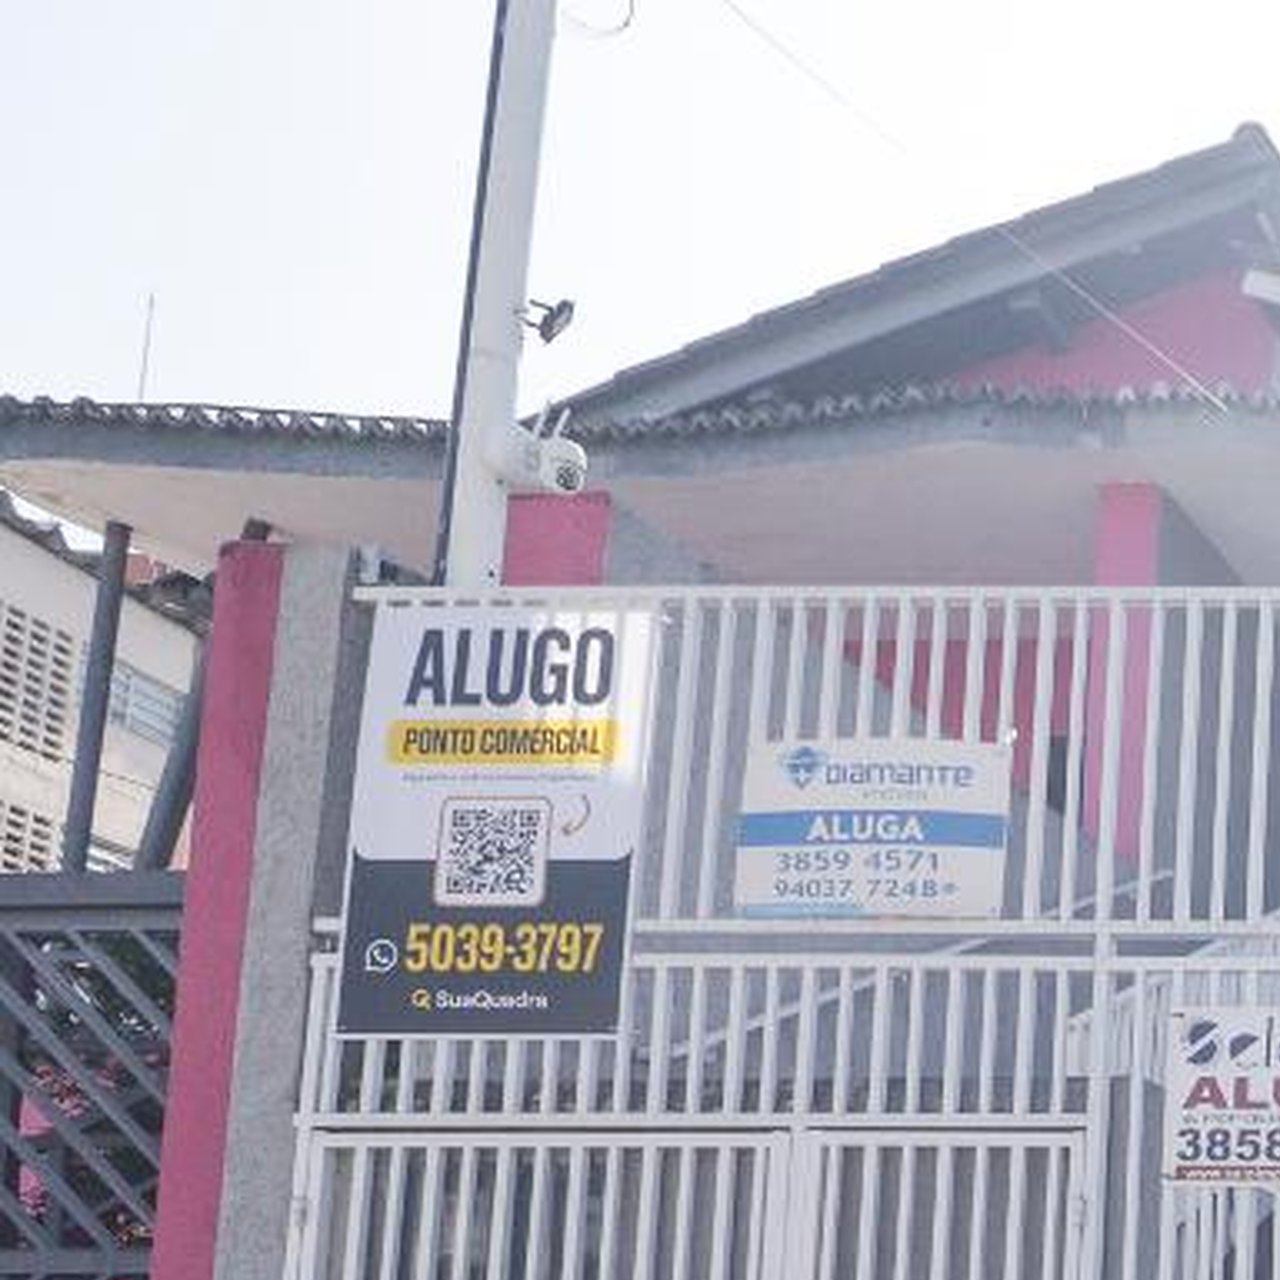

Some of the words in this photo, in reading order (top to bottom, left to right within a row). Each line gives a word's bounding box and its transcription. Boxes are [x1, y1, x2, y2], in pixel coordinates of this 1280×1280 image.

[405, 628, 615, 708] ALUGO
[403, 728, 475, 755] PONTO
[479, 727, 602, 756] COMERCIAL
[806, 815, 924, 842] ALUGA
[776, 851, 850, 871] 3859
[864, 850, 938, 871] 4571
[405, 923, 603, 973] 5039-3797
[434, 988, 548, 1010] SuaQuadra
